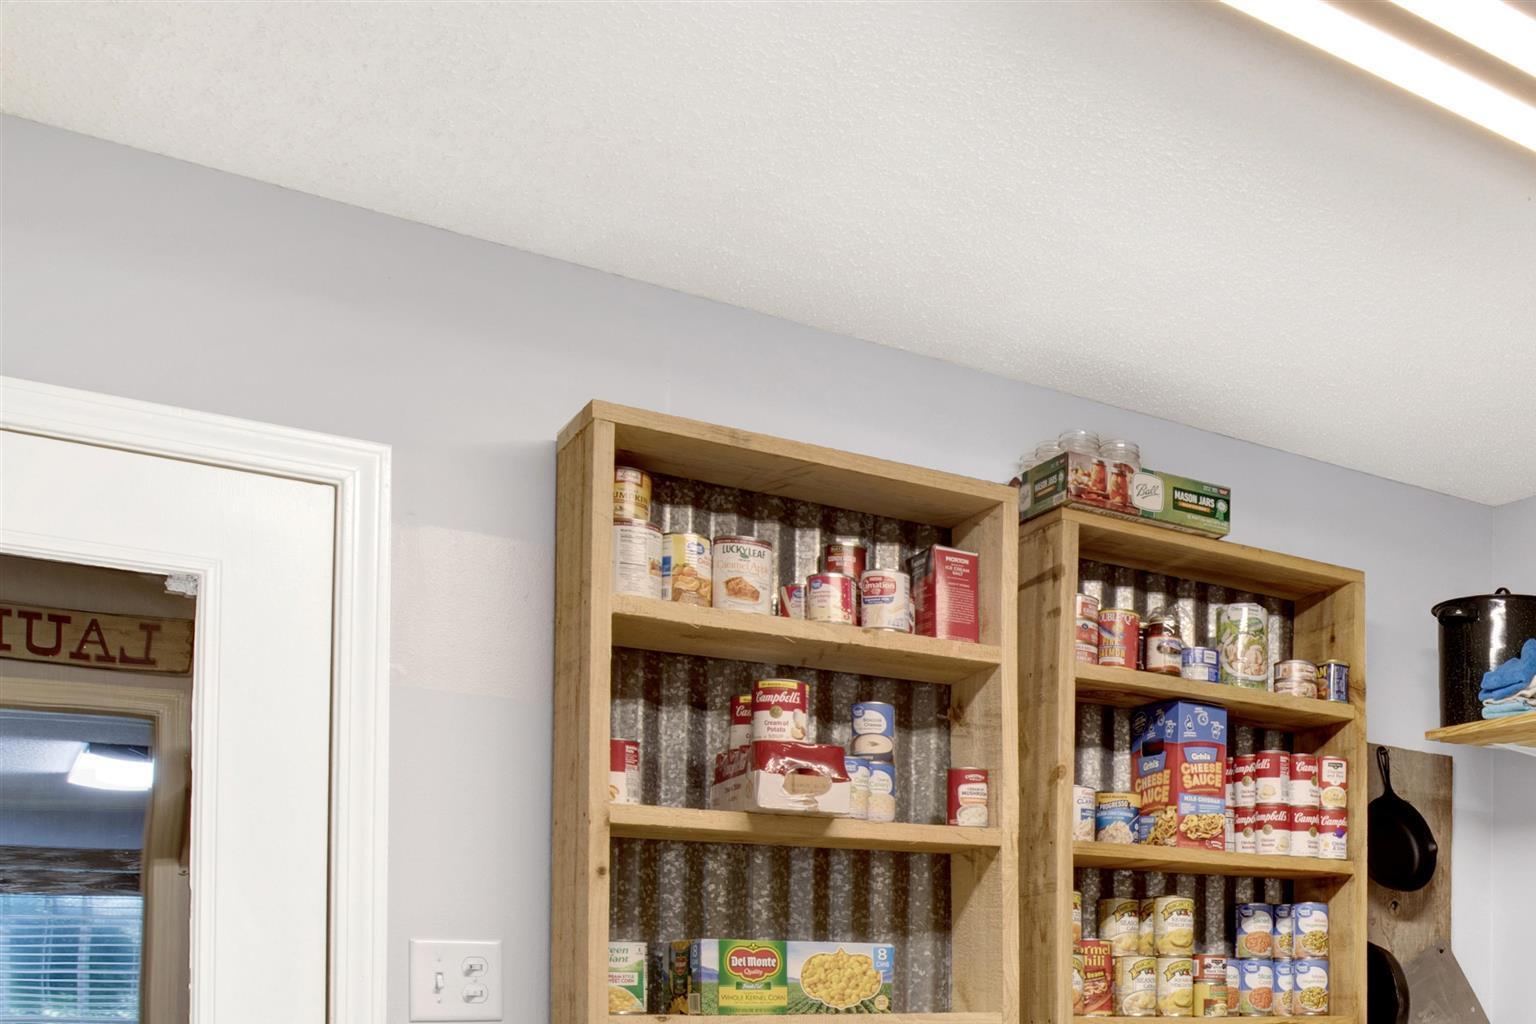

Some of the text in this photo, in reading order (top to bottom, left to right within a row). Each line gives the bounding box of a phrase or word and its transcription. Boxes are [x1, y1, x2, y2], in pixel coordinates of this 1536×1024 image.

[1136, 484, 1161, 499] Ball
[1174, 490, 1215, 508] MASON JARS
[722, 545, 766, 559] LUCKY LEAF
[756, 690, 802, 704] Campbell's
[1181, 762, 1223, 774] CHEESE
[1182, 774, 1222, 789] SAUCE
[1142, 786, 1169, 804] AUCE
[732, 956, 777, 967] Del Monte
[878, 949, 887, 960] 8
[1085, 956, 1105, 966] hili
